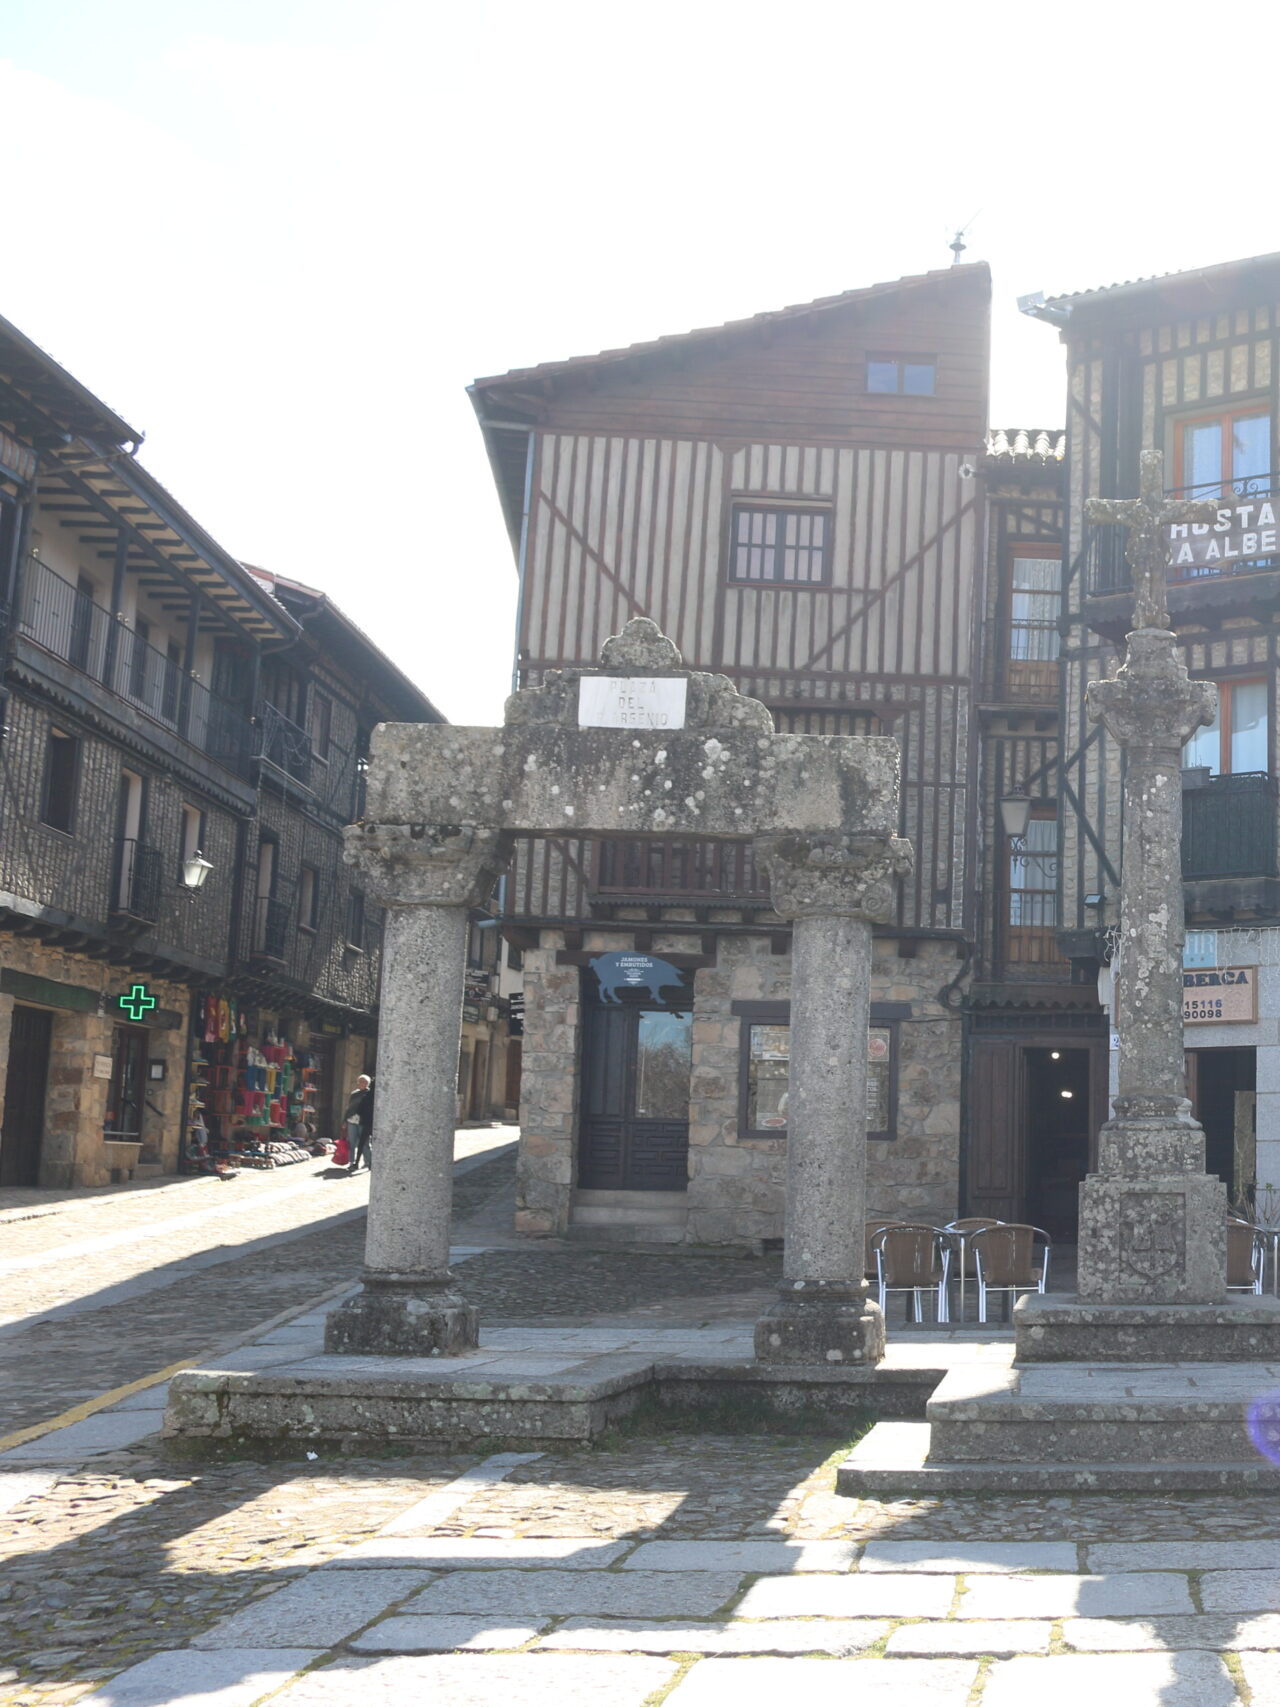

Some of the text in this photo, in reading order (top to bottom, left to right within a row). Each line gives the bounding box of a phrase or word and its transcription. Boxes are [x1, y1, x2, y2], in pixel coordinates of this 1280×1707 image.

[1168, 542, 1194, 565] A
[610, 680, 656, 693] PLAZA
[619, 696, 644, 709] DEL
[1183, 971, 1249, 988] BERCA
[1184, 999, 1222, 1010] 15116
[1183, 1009, 1222, 1019] 90098
